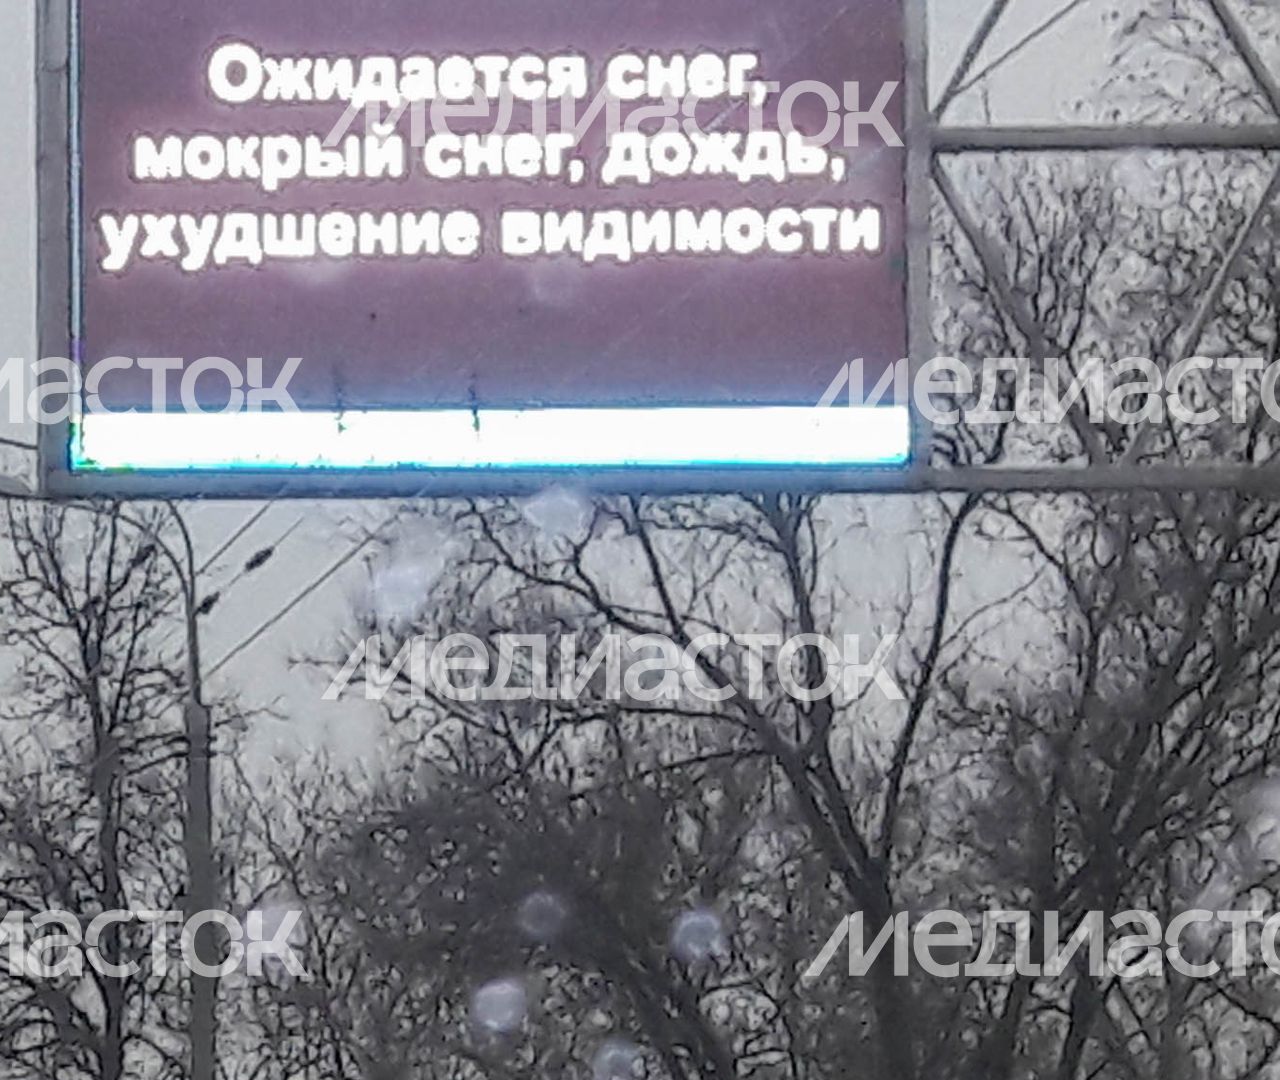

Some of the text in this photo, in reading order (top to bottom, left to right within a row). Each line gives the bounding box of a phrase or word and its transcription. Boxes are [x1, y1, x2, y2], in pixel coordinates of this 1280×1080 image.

[206, 42, 769, 110] Ожидается снег,
[132, 121, 846, 190] мокрый снег, дождь,
[98, 206, 880, 271] ухудшение видимости
